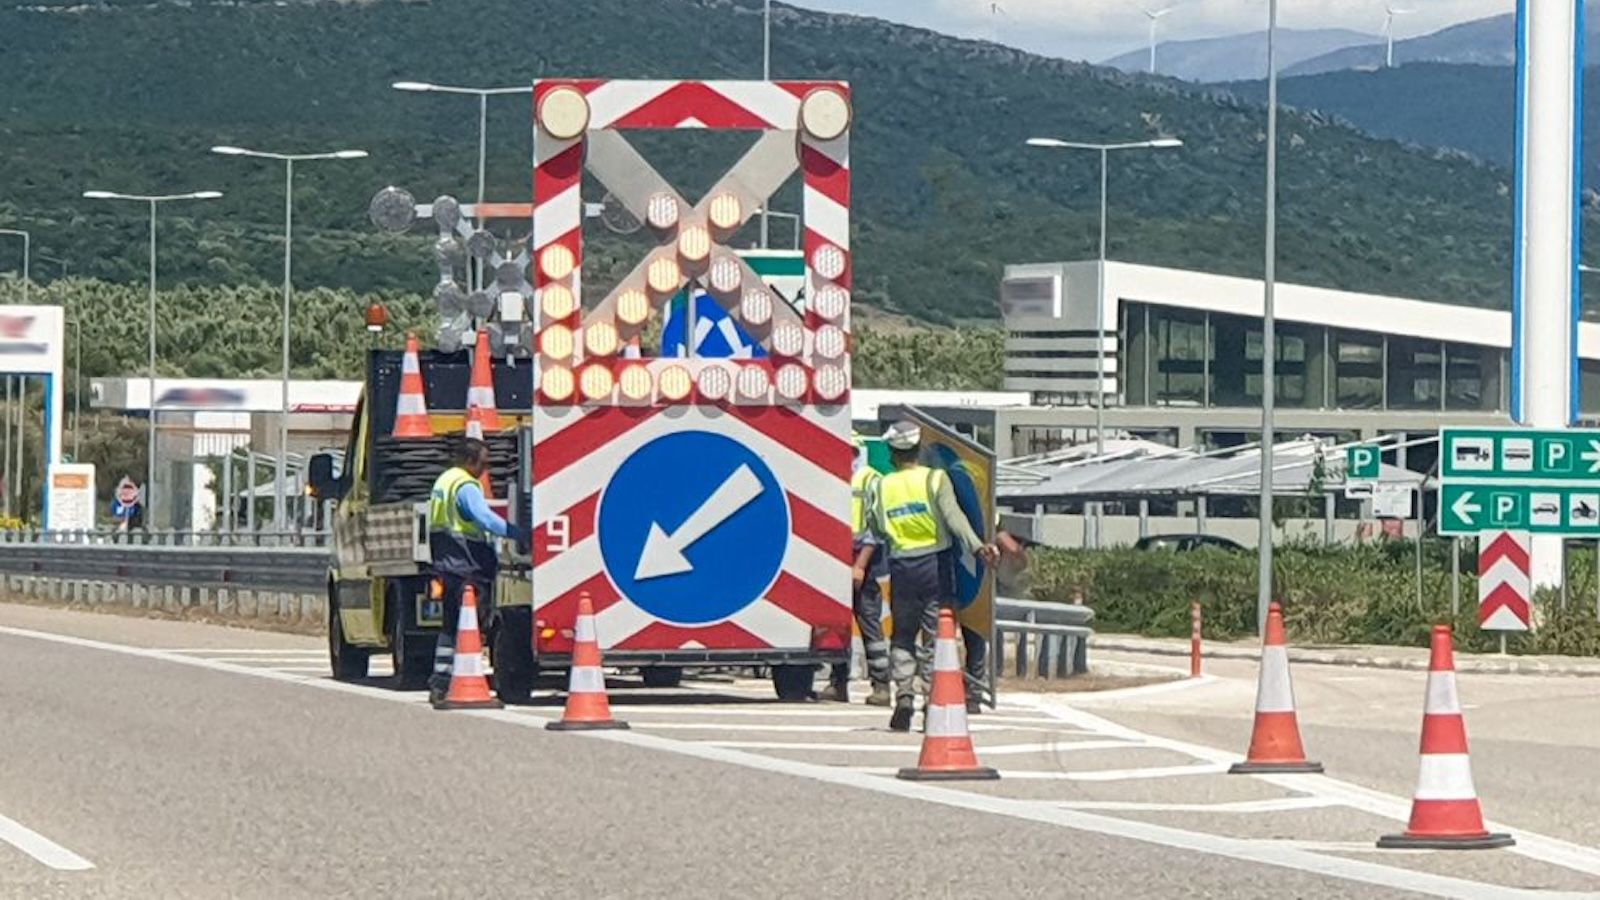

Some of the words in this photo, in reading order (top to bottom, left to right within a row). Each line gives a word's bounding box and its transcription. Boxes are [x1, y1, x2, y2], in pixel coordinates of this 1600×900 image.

[1353, 449, 1372, 475] P
[1548, 443, 1565, 467] P
[1498, 496, 1514, 520] P
[547, 515, 569, 551] 9
